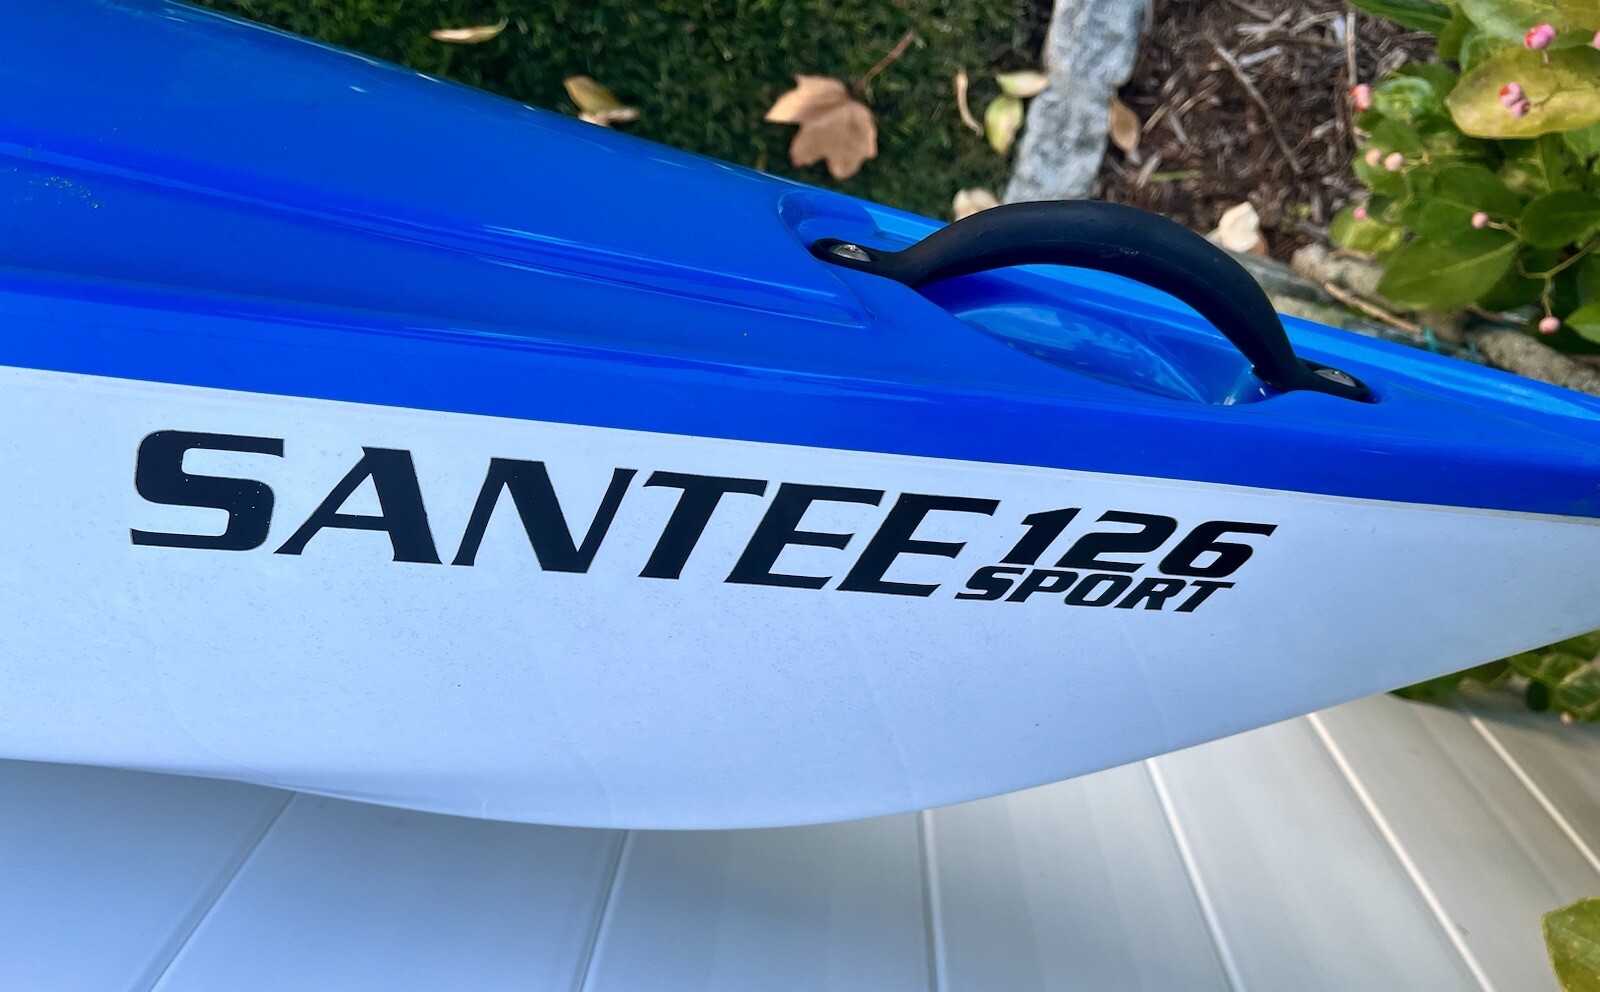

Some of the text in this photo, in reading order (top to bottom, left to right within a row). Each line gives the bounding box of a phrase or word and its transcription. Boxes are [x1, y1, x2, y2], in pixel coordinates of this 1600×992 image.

[130, 429, 1278, 598] SANTEE 126
[954, 565, 1236, 613] SPORT
